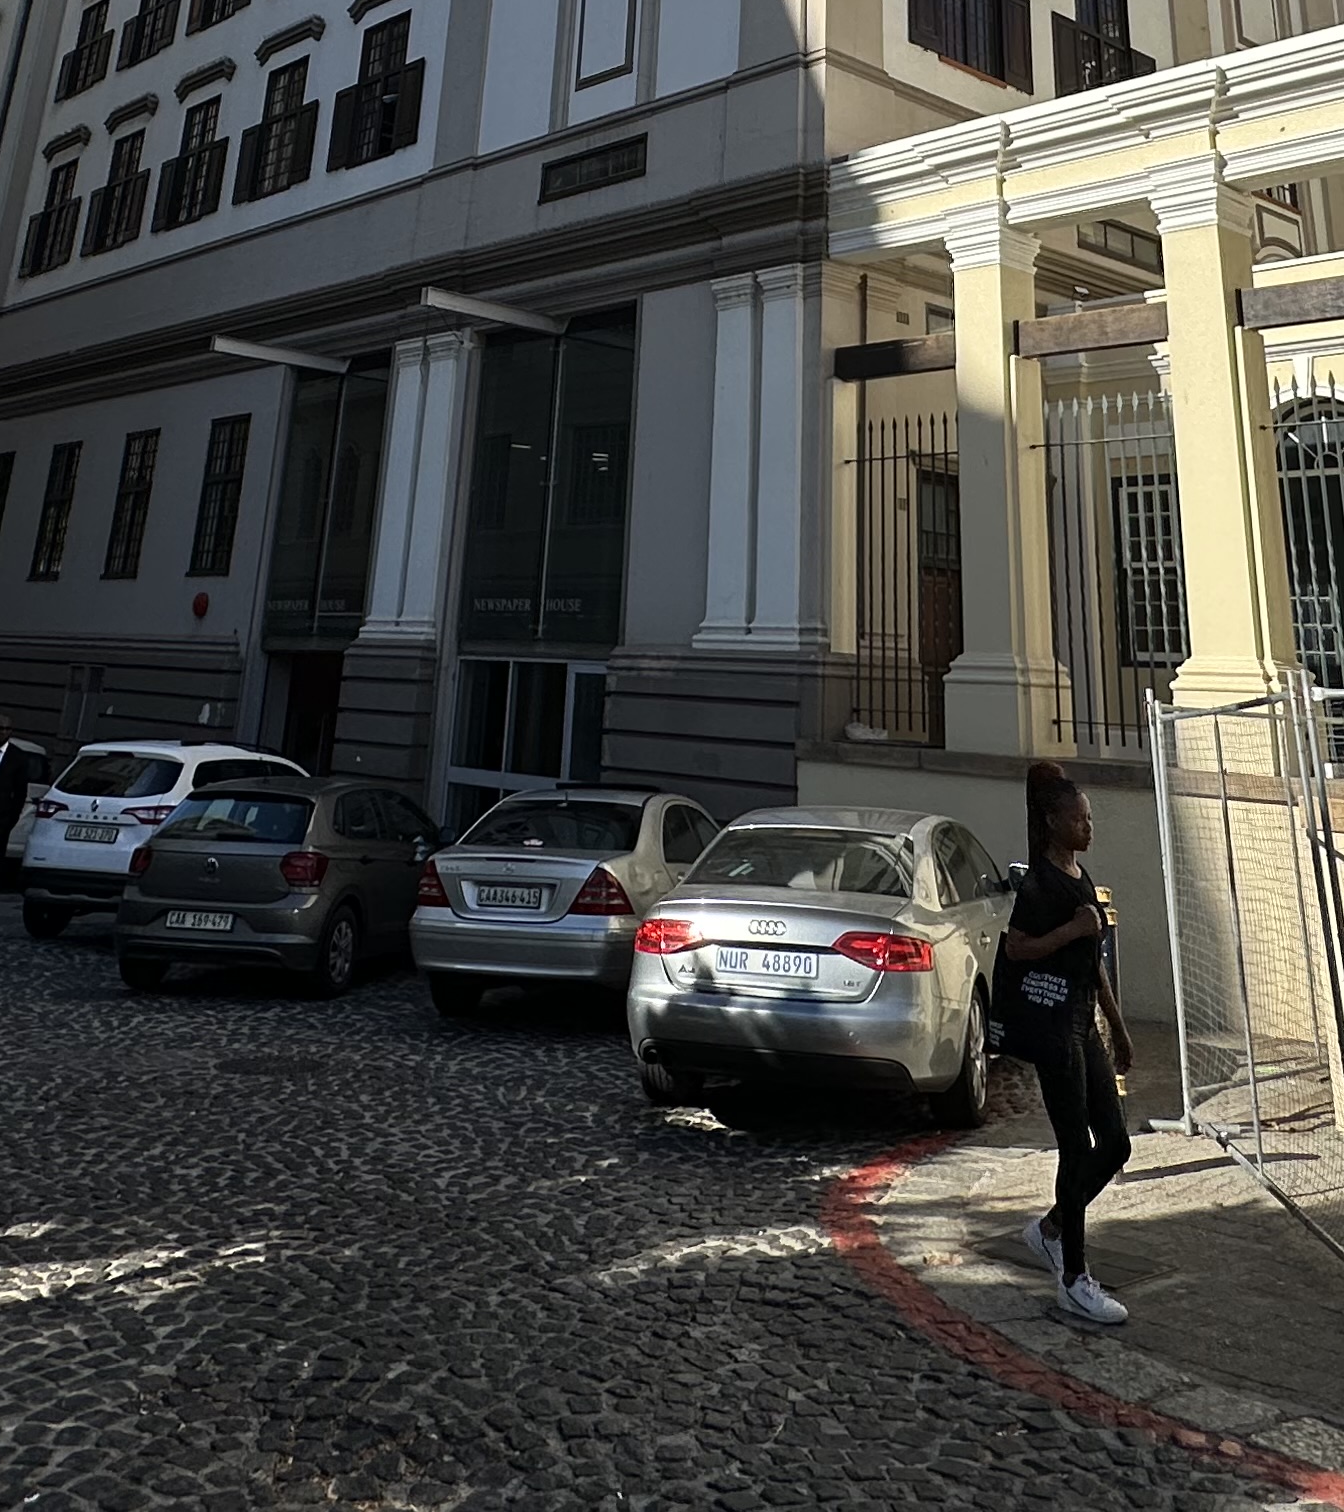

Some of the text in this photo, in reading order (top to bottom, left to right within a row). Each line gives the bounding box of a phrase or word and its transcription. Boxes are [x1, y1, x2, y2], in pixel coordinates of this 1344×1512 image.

[473, 598, 582, 612] NEWSPAPER HOUSE
[718, 950, 812, 974] NUR 48890
